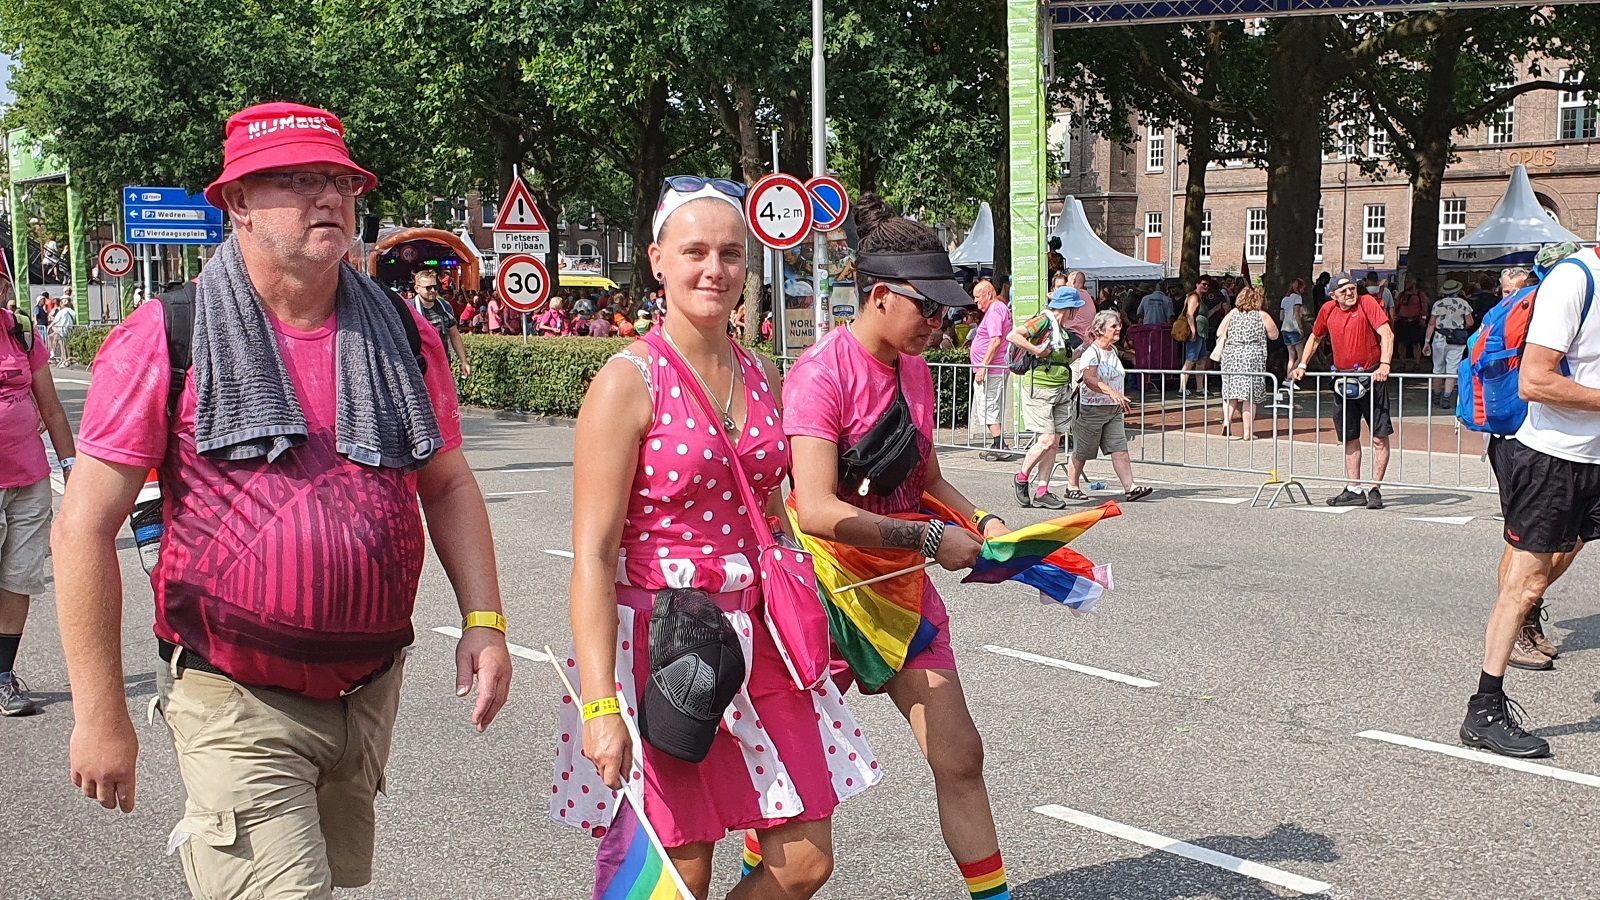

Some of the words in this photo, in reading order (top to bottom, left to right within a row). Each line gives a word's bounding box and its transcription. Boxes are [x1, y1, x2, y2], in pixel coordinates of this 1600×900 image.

[1507, 149, 1556, 168] OPUS
[760, 201, 791, 221] 4,2
[793, 208, 803, 218] m
[147, 230, 205, 238] Vierdaagseplein
[505, 233, 540, 241] Fietsers
[515, 241, 545, 252] rijbaan
[1457, 250, 1478, 259] Friet
[507, 272, 541, 294] 30
[790, 320, 815, 328] WORL
